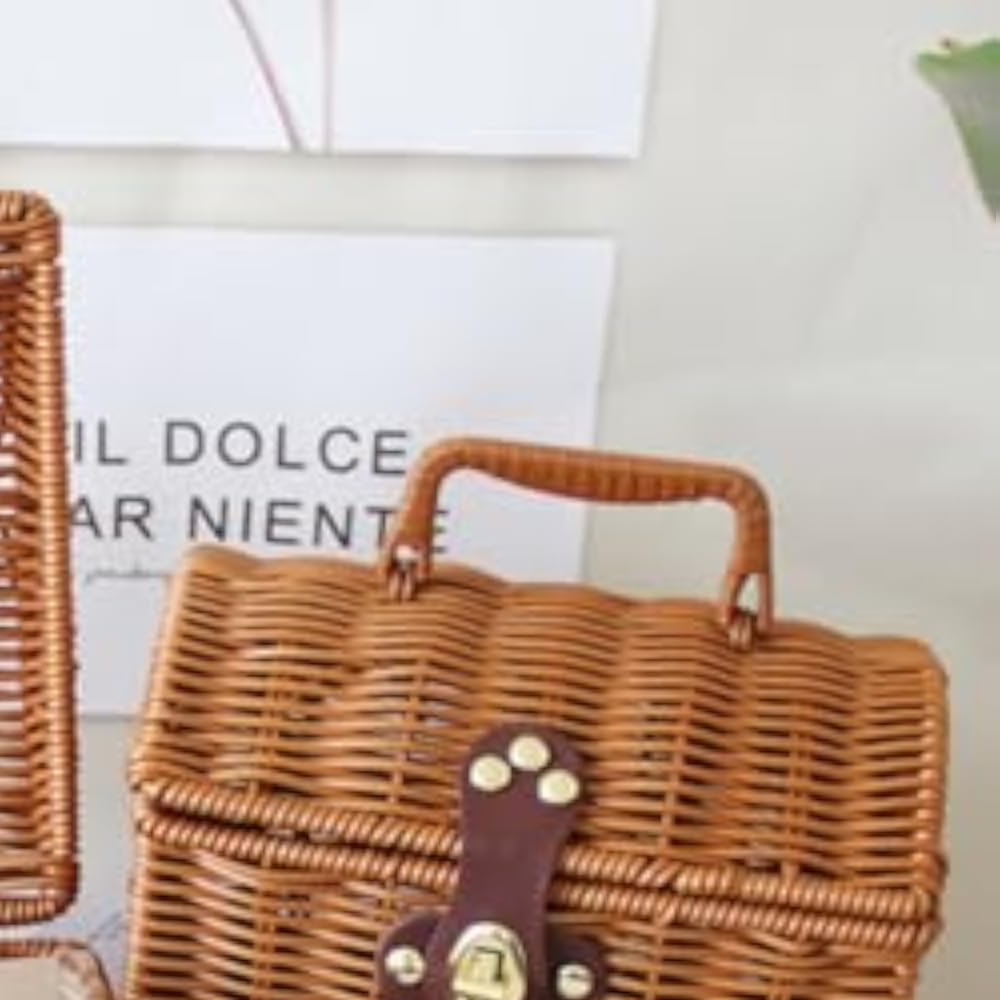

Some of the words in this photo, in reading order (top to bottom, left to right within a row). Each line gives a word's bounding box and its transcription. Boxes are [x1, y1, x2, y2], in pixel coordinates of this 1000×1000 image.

[75, 420, 128, 466] IL
[164, 420, 408, 476] DOLCE
[70, 494, 154, 541] AR
